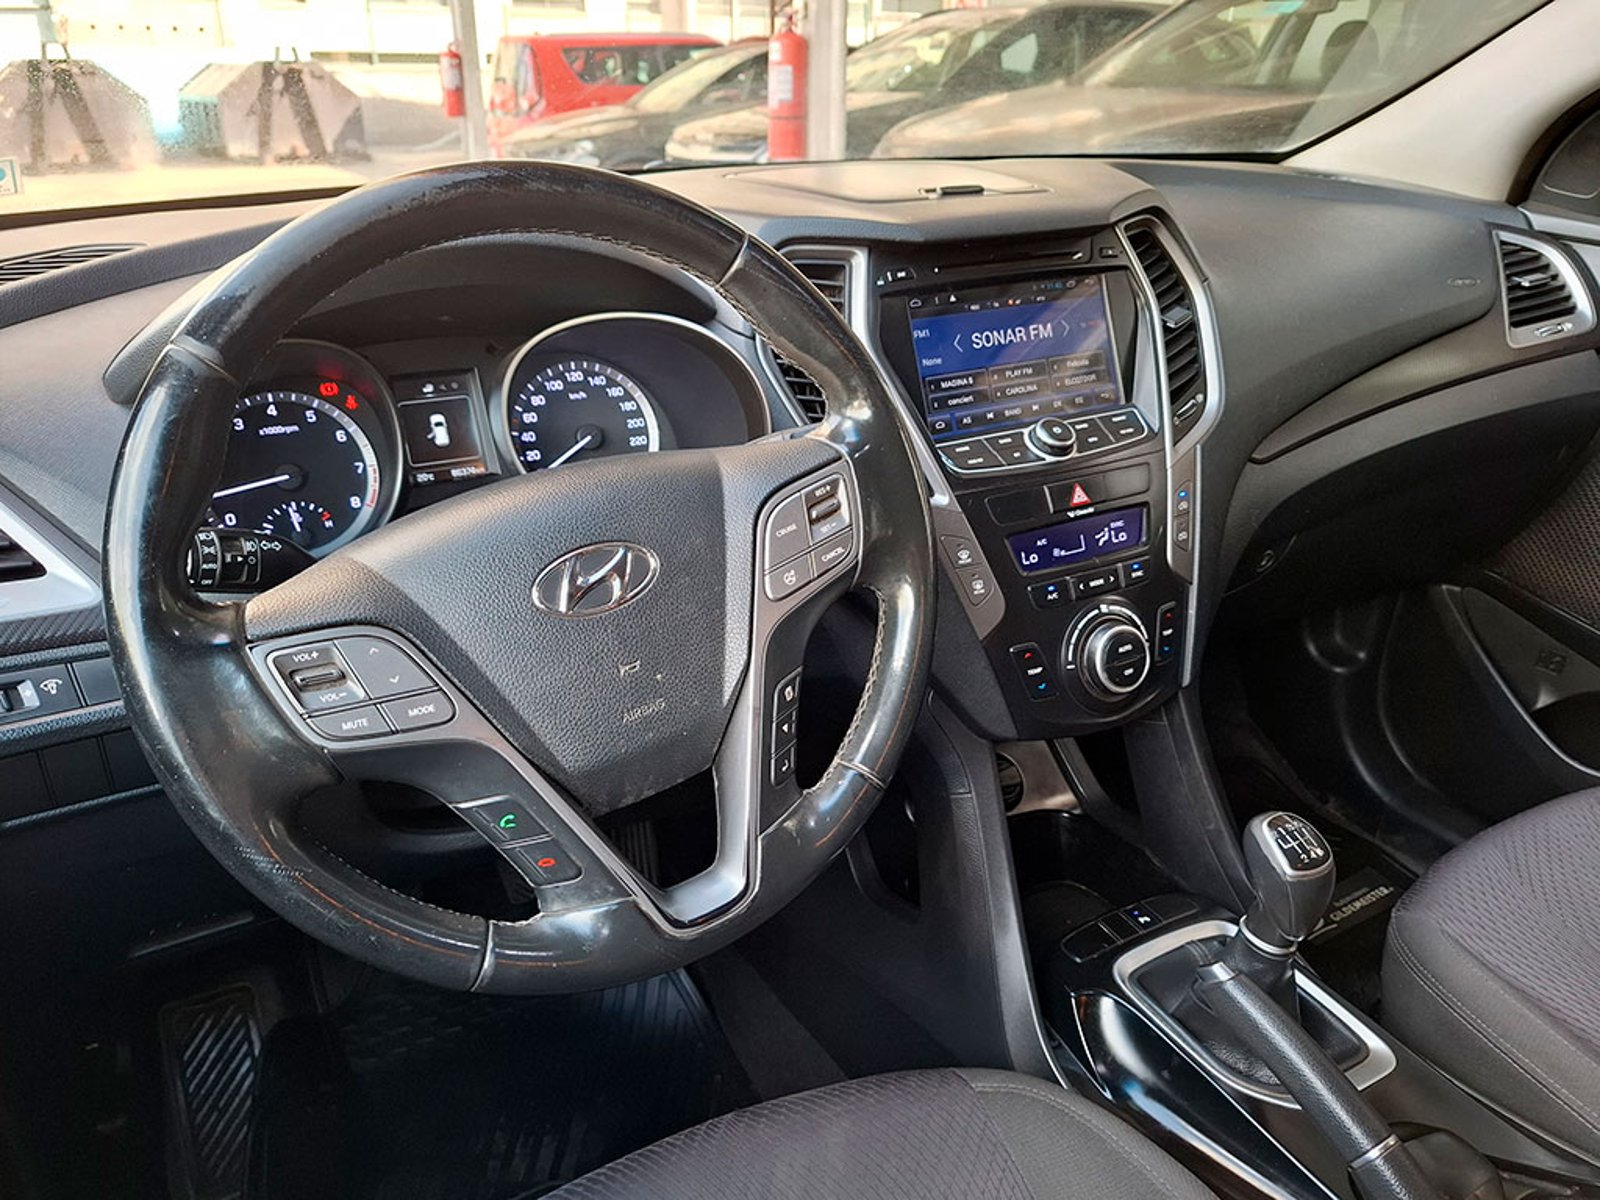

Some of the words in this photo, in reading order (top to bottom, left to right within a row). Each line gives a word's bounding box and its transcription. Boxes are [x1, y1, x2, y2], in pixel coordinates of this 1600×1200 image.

[971, 328, 1026, 349] SONAR
[1029, 323, 1053, 341] FM
[922, 358, 942, 367] None
[565, 371, 583, 382] 120
[1005, 369, 1022, 378] PLAY
[544, 379, 563, 391] 100
[587, 375, 606, 387] 140
[605, 386, 624, 397] 160
[1005, 384, 1038, 396] CAROLINA
[531, 394, 546, 406] 80
[619, 400, 637, 412] 180
[267, 404, 278, 416] 4
[306, 411, 316, 423] 5
[522, 411, 538, 424] 60
[626, 417, 645, 428] 200
[233, 418, 244, 430] 3
[336, 431, 347, 442] 6
[521, 431, 536, 442] 40
[629, 435, 648, 446] 220
[526, 450, 541, 461] 20
[354, 462, 365, 474] 7
[350, 496, 361, 508] 8
[224, 514, 237, 526] 0
[1111, 530, 1128, 543] Lo
[821, 546, 845, 562] CANCEL
[1021, 551, 1039, 565] Lo
[407, 703, 436, 718] MODE
[622, 698, 665, 723] AIRBAG
[341, 717, 369, 731] MUTE
